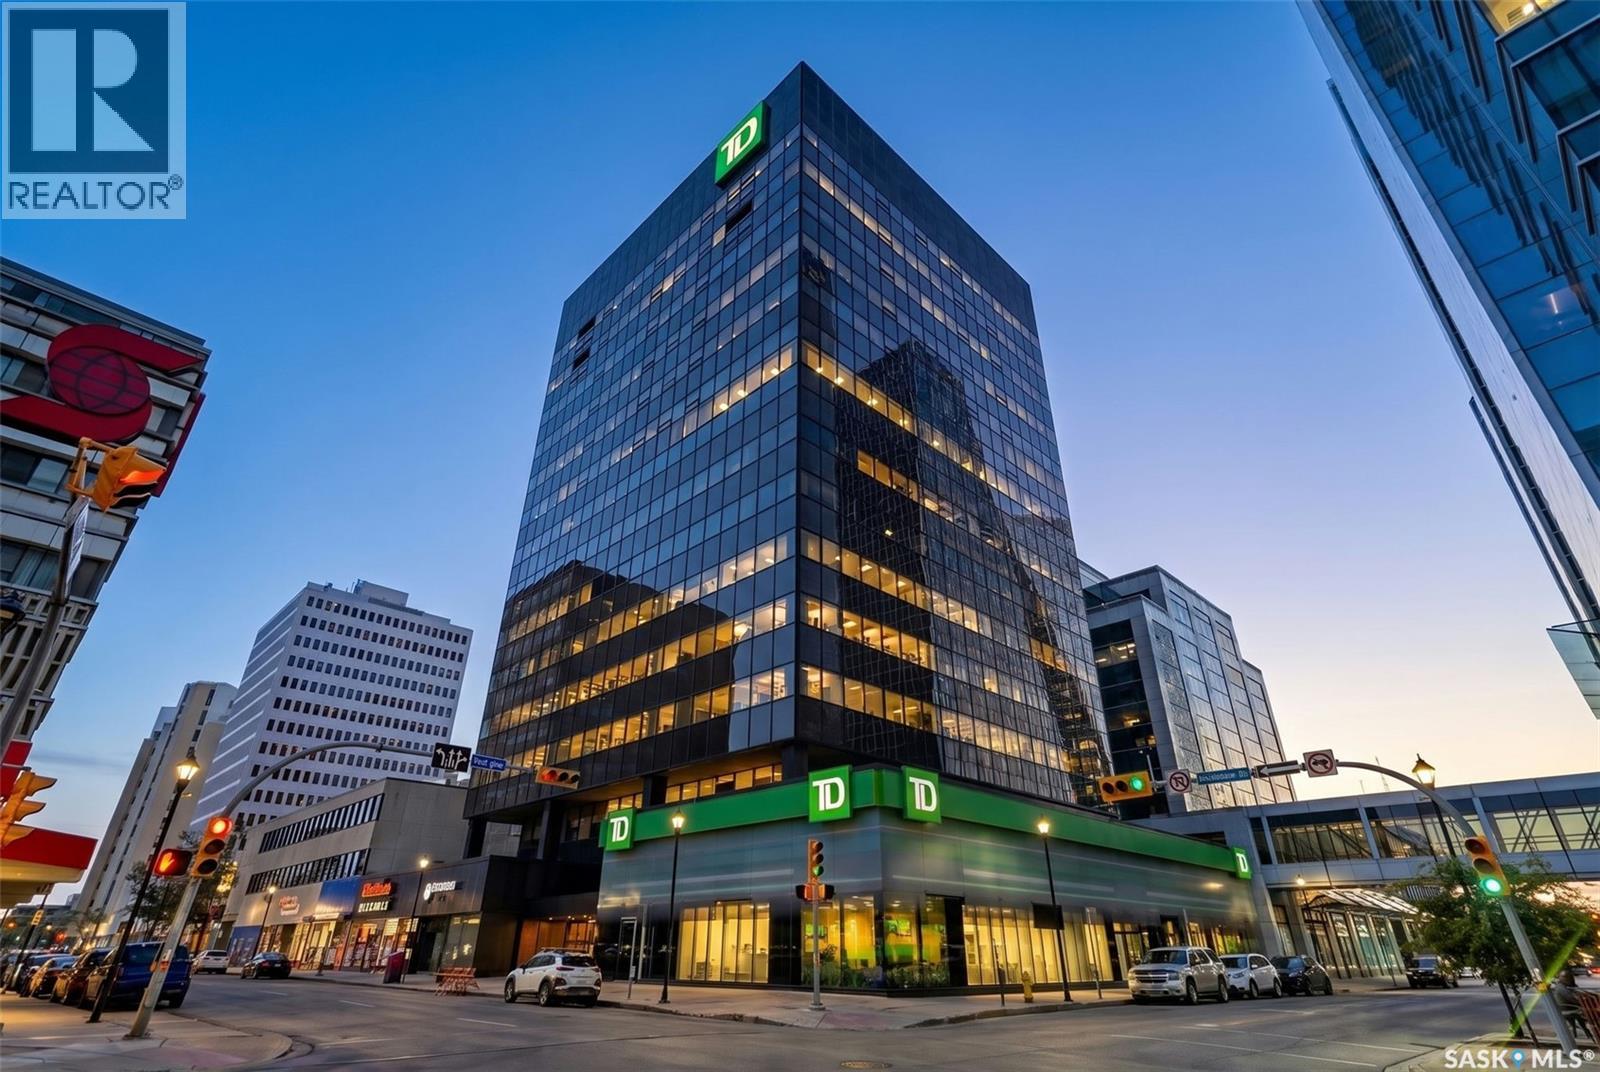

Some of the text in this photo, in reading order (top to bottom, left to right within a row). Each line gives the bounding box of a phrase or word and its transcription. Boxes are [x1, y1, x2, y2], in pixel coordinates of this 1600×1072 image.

[720, 116, 758, 166] TD
[812, 776, 845, 811] TD
[909, 776, 938, 812] TD
[609, 816, 629, 842] TD
[1235, 852, 1249, 873] TD
